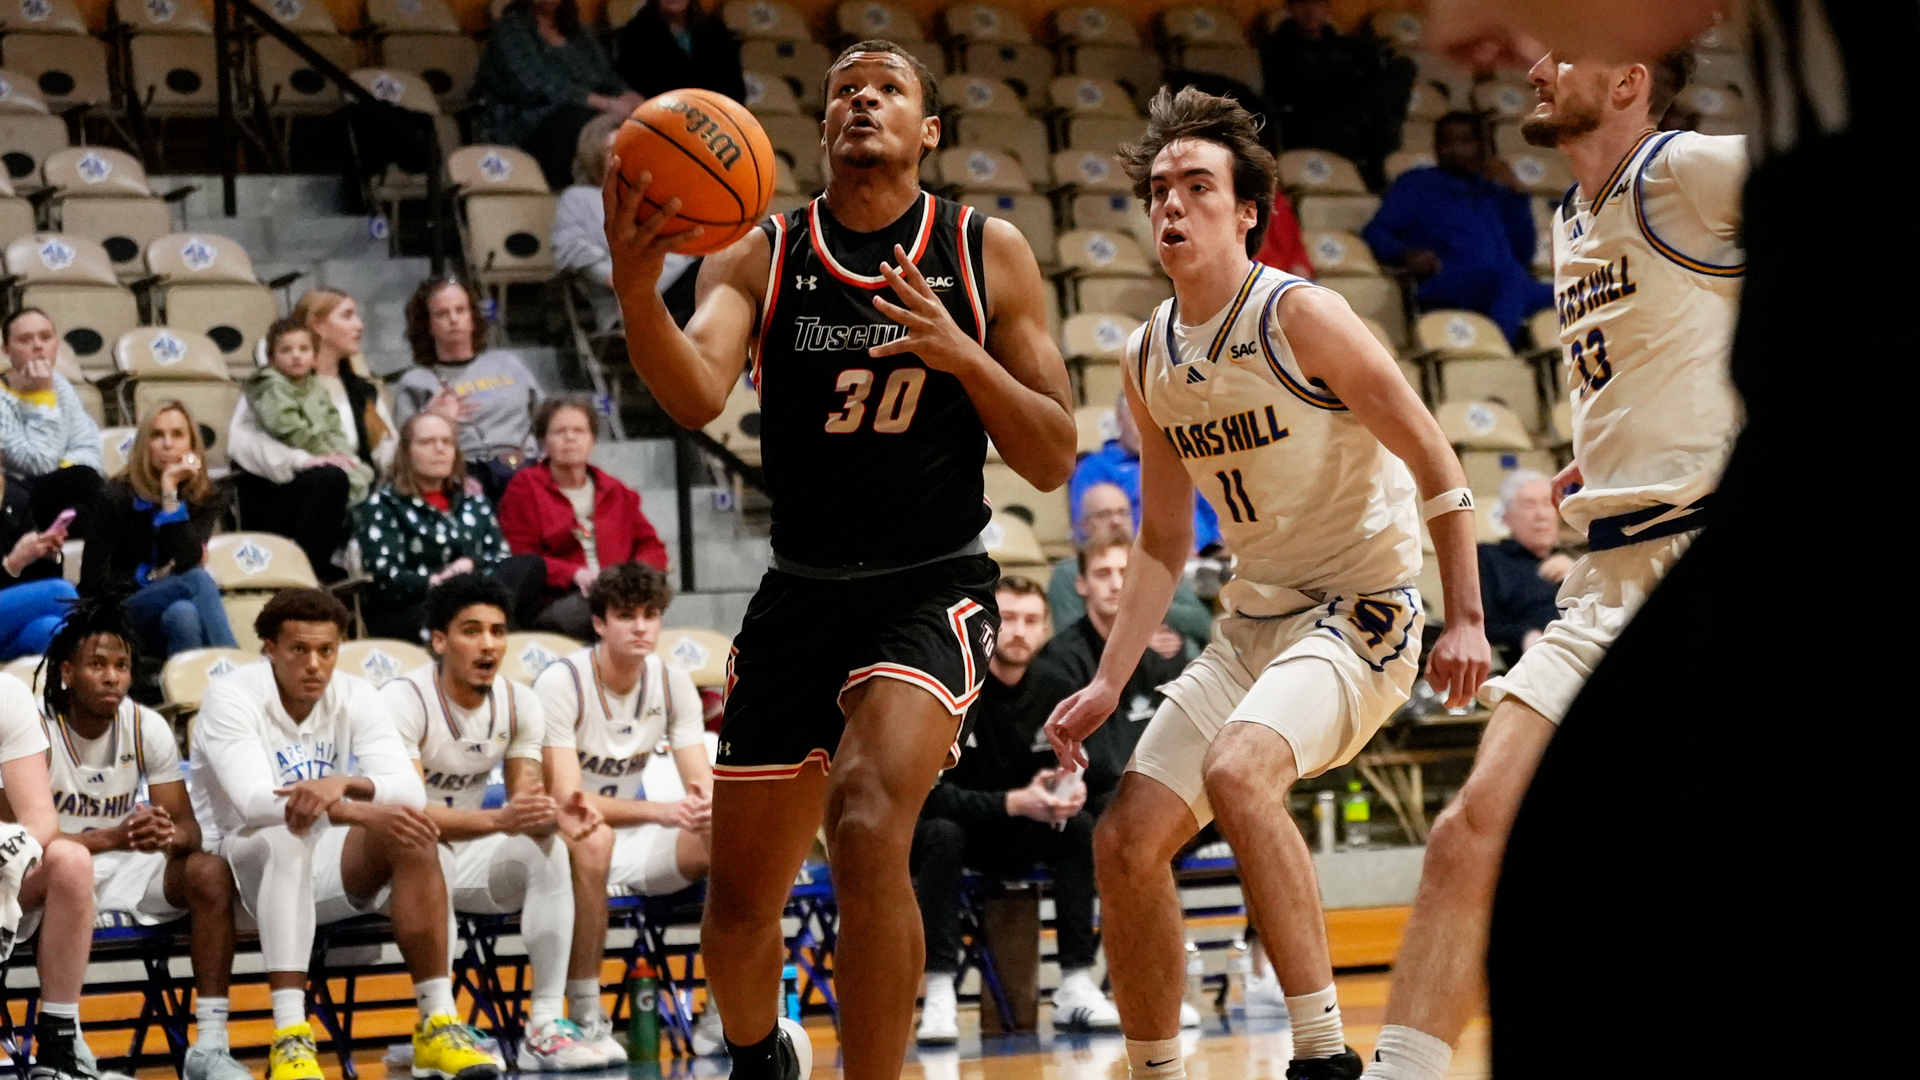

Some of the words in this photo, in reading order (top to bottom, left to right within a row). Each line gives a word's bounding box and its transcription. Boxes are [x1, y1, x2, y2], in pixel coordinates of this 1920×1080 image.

[926, 276, 954, 288] SAC
[1230, 341, 1258, 359] SAC
[824, 367, 927, 434] 30
[1215, 468, 1259, 523] 11
